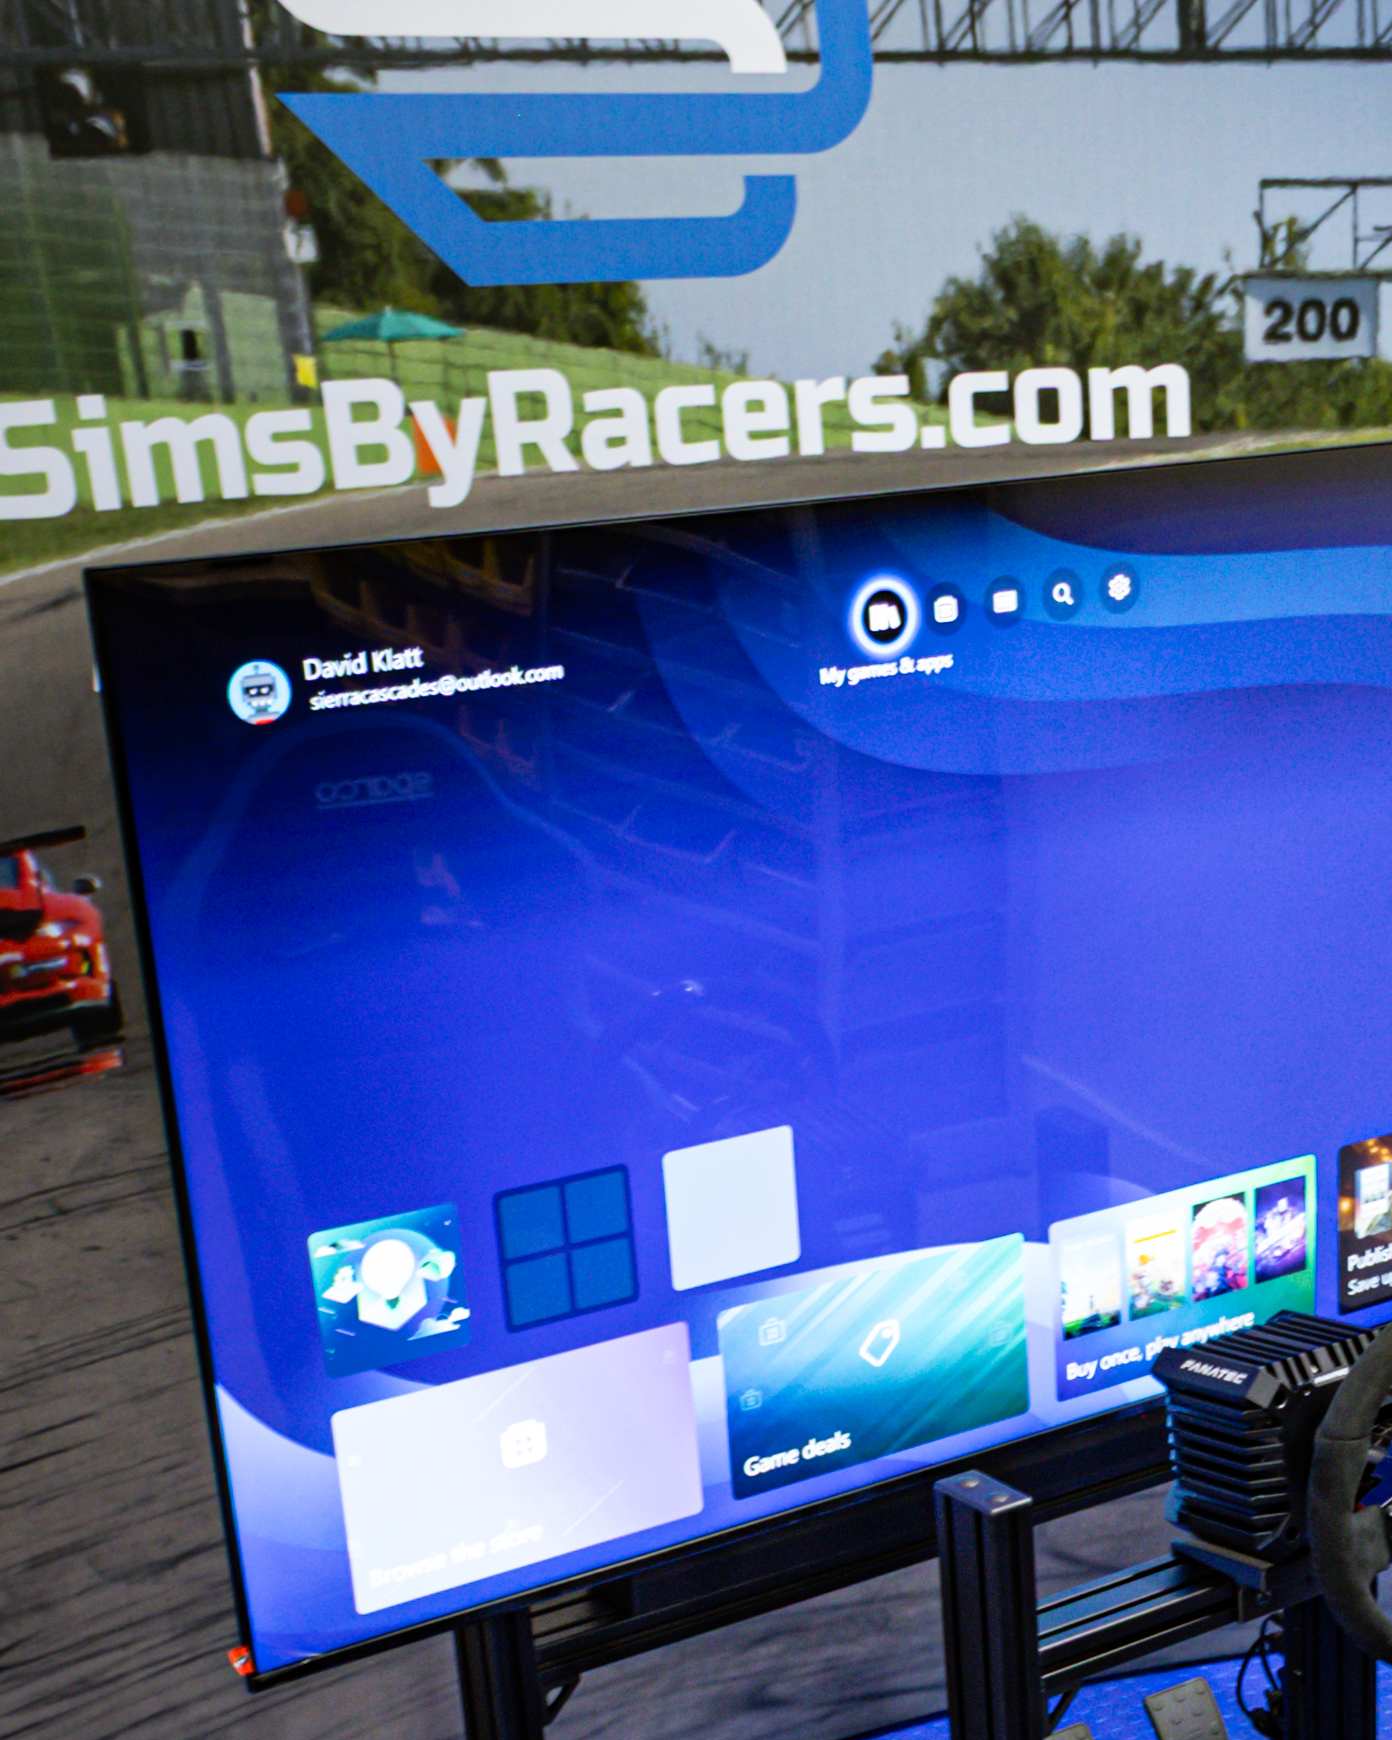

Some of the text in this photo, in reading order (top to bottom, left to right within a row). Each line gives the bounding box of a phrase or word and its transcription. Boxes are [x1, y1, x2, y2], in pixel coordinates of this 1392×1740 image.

[1263, 296, 1361, 344] 200
[0, 362, 1191, 520] SimsByRacers.com
[302, 645, 425, 681] David Klatt
[819, 666, 846, 688] My
[846, 661, 898, 686] games
[916, 653, 954, 676] apps
[308, 664, 565, 711] sierracascades@outlook.com
[1347, 1275, 1380, 1296] Save
[1065, 1359, 1098, 1381] Buy
[1099, 1346, 1144, 1371] once,
[1181, 1311, 1255, 1344] anywhere
[1180, 1359, 1249, 1385] FANATEC
[743, 1430, 852, 1477] Game deals
